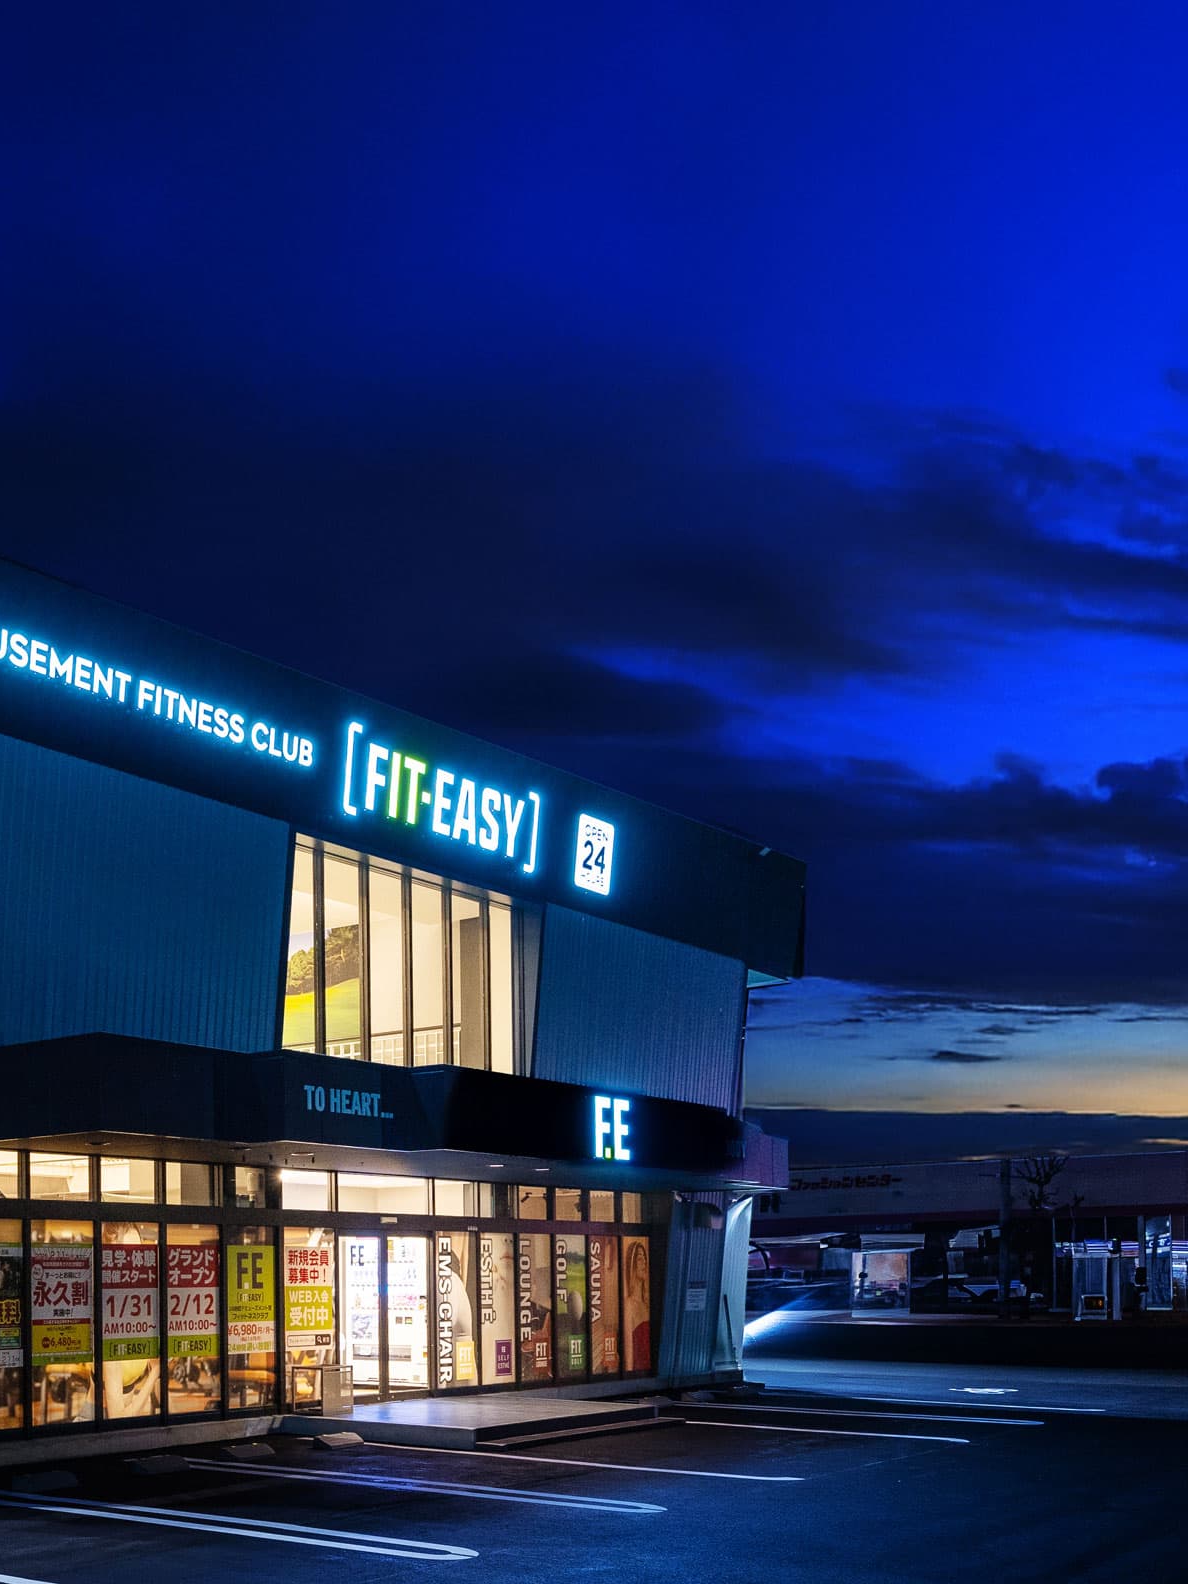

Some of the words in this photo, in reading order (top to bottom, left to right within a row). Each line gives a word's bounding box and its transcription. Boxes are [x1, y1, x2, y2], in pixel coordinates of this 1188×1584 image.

[137, 680, 244, 744] FITNESS
[250, 722, 314, 767] CLUB
[582, 840, 606, 874] 24
[304, 1085, 325, 1112] TO
[168, 1248, 215, 1267] グランド
[288, 1249, 330, 1266] 新規会員
[102, 1269, 157, 1284] 開催スタート
[168, 1267, 216, 1285] オープン
[556, 1239, 567, 1304] GOLF
[590, 1241, 603, 1323] SAUNA
[33, 1280, 88, 1307] 永久割
[288, 1289, 330, 1304] WEB入会
[519, 1239, 533, 1343] LOUNGE
[106, 1294, 152, 1318] 1/31
[170, 1293, 215, 1316] 2/12
[289, 1305, 329, 1327] 受付中
[437, 1235, 454, 1385] EMS-CHAIR
[535, 1342, 547, 1357] FIT
[570, 1340, 582, 1354] FIT
